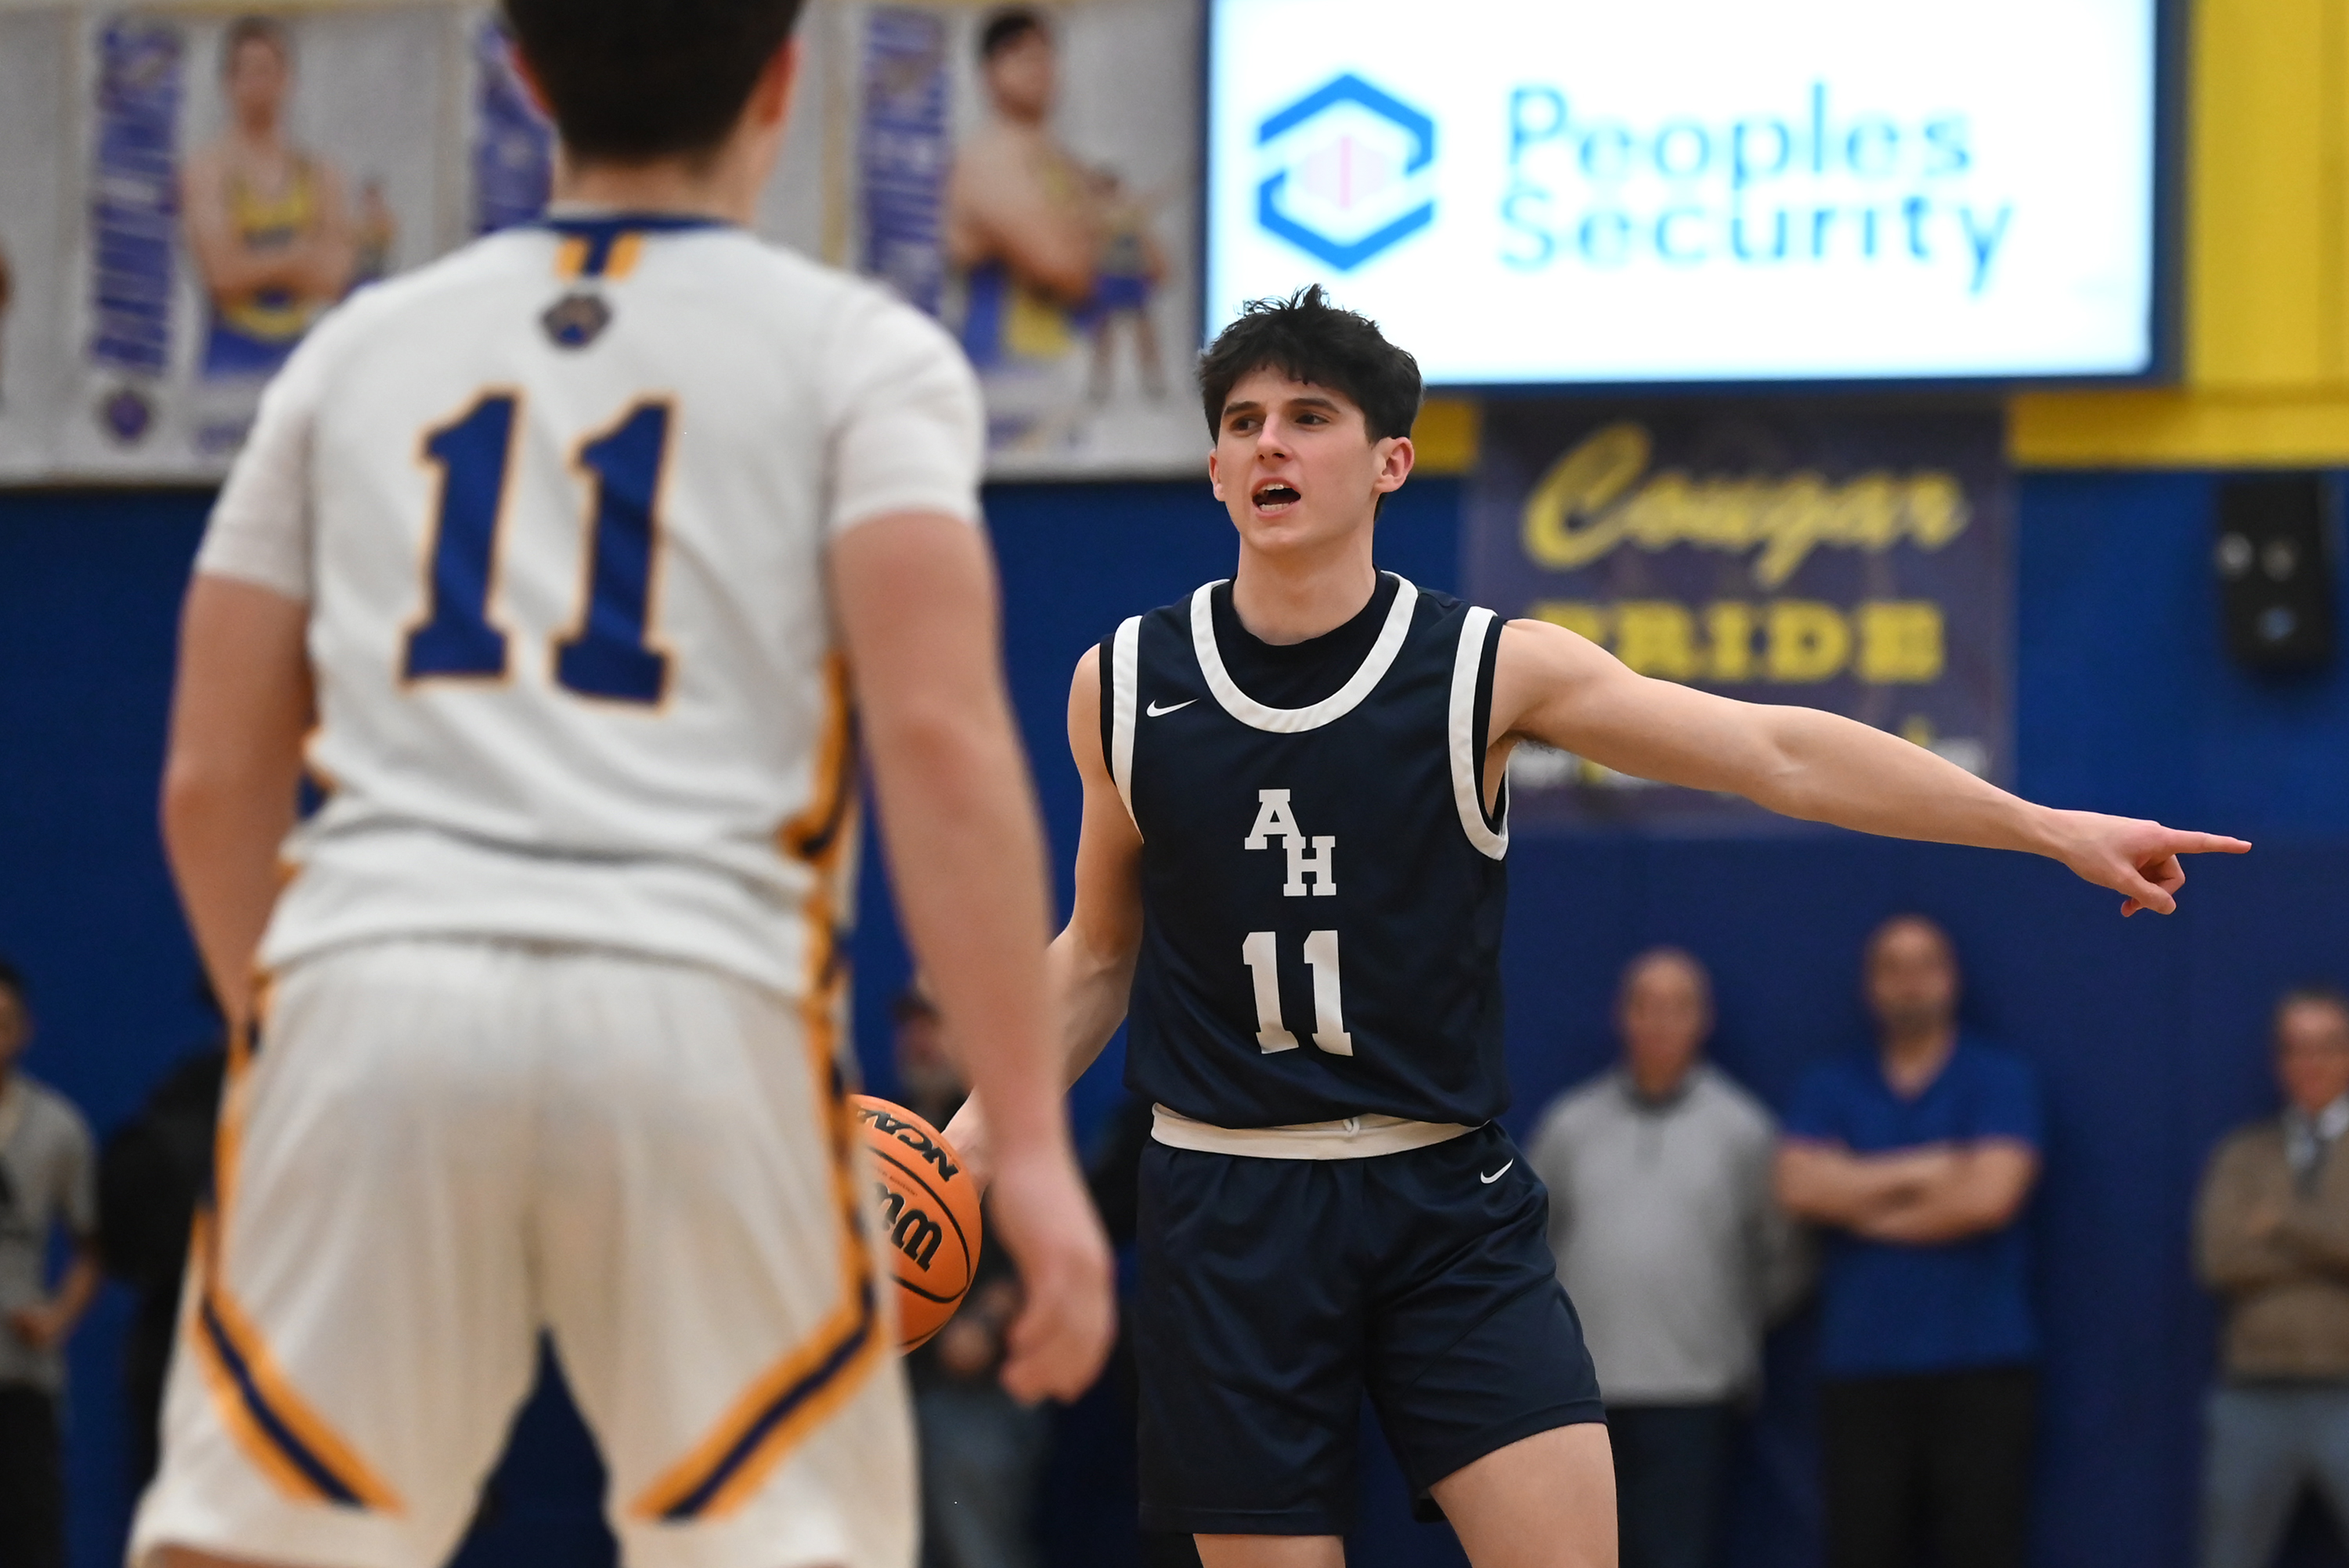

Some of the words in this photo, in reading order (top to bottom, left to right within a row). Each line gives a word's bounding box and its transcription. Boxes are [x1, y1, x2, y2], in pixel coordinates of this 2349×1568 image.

[1504, 81, 1973, 193] Peoples
[1498, 182, 2015, 297] Security
[397, 384, 681, 716] 11
[1522, 421, 1970, 589] Cougar
[1244, 788, 1337, 896] AH
[1242, 930, 1354, 1057] 11
